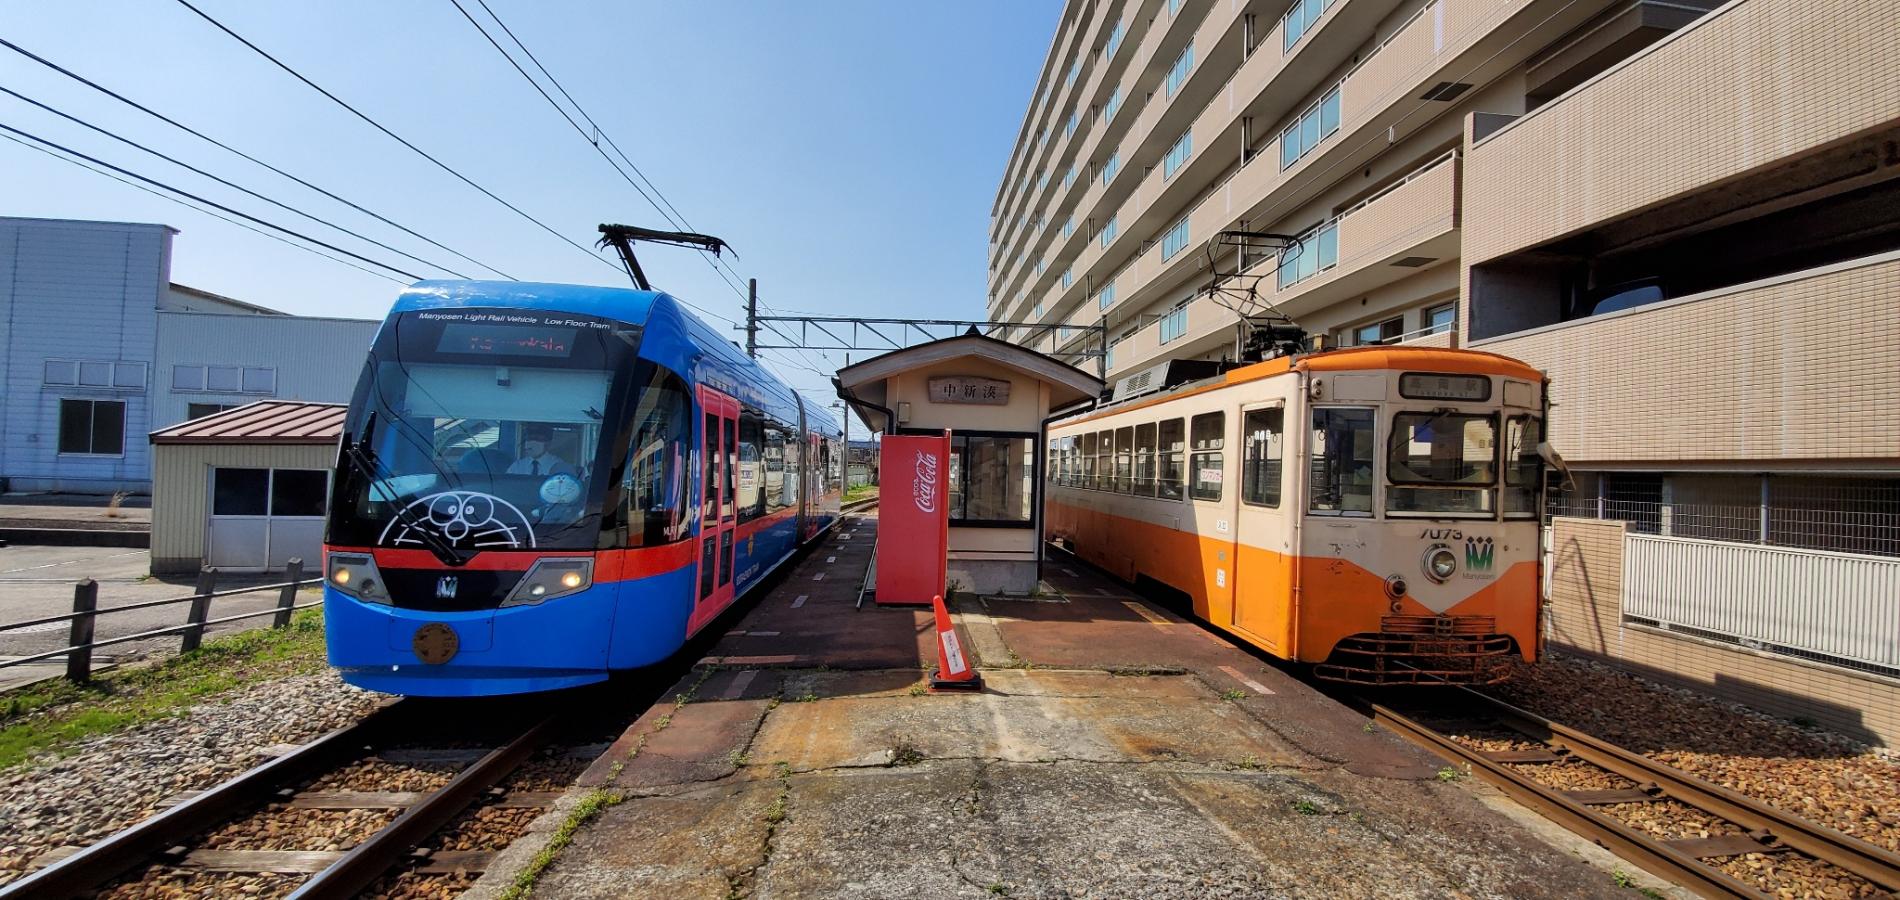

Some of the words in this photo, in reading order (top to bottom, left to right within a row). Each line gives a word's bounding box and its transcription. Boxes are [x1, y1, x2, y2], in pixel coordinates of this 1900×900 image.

[419, 313, 463, 321] Manyosen
[464, 314, 486, 322] Light
[487, 314, 506, 322] Rail
[507, 316, 538, 324] Vehicle
[544, 318, 562, 326] Low
[565, 319, 588, 327] Floor
[590, 321, 611, 330] Tram
[943, 383, 997, 399] 中新湊
[1420, 529, 1463, 541] 7073
